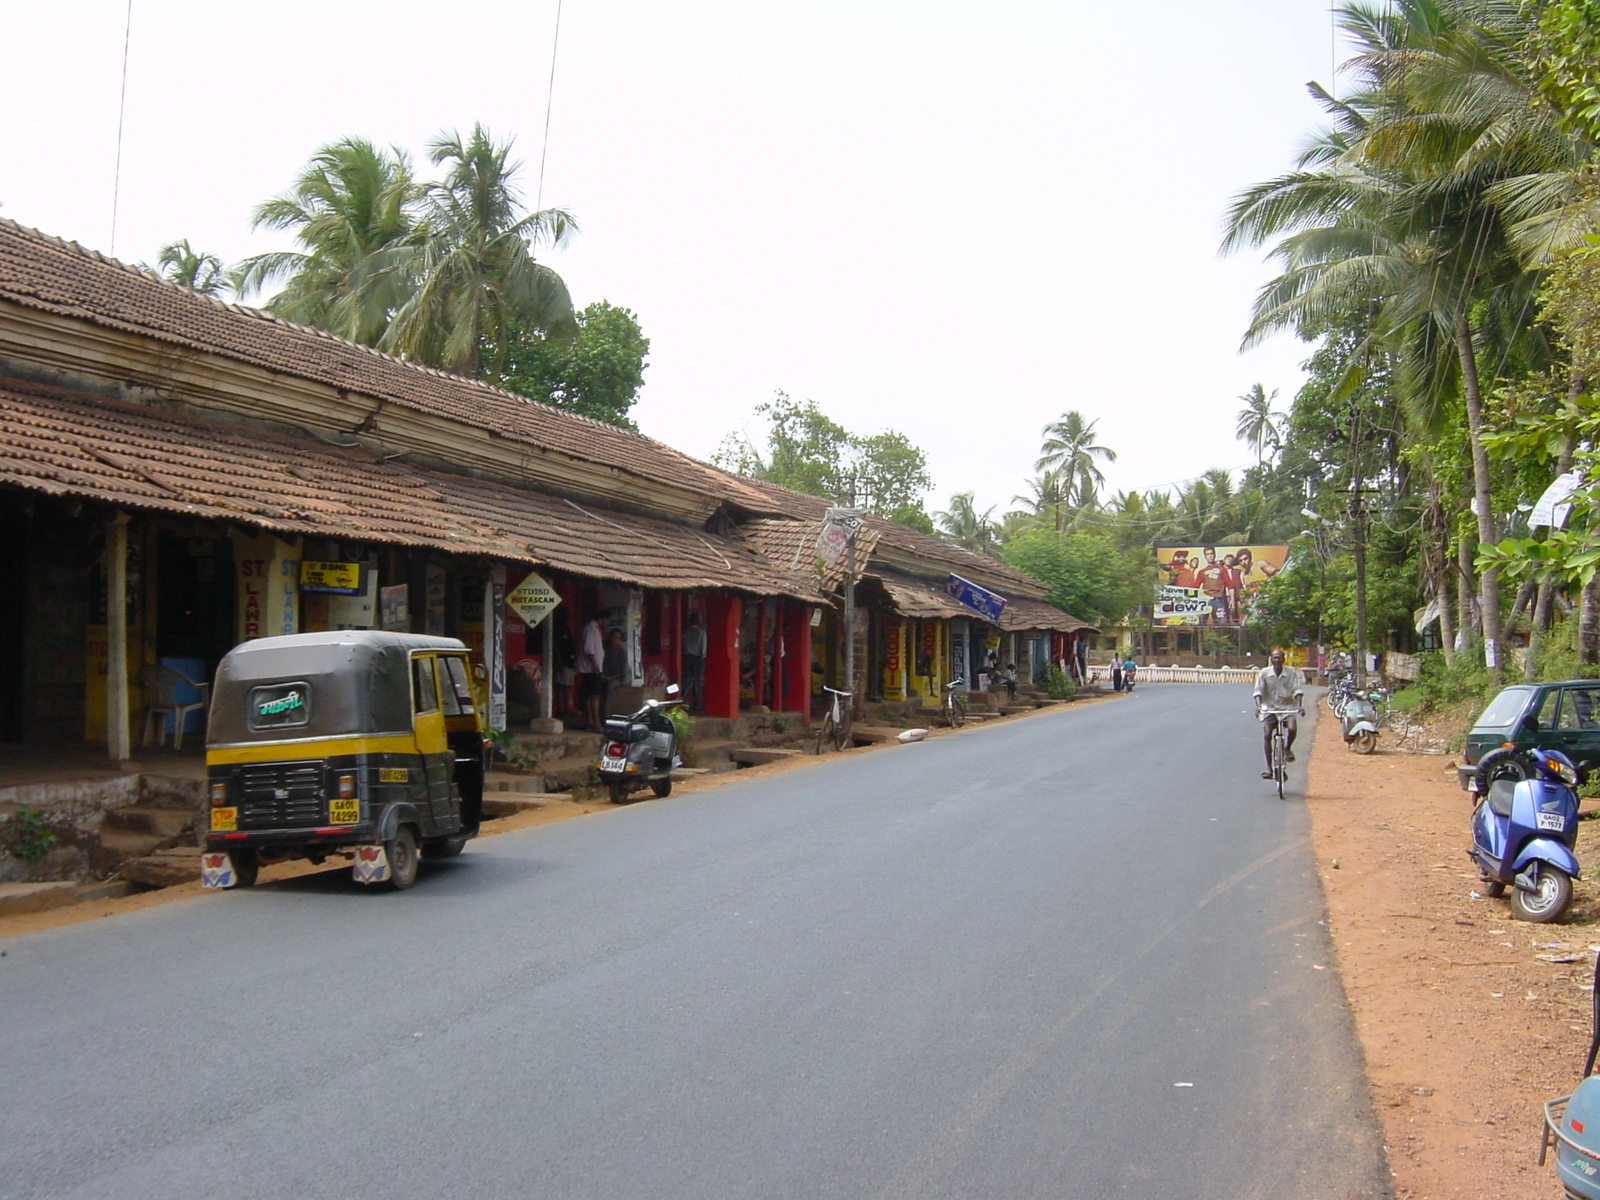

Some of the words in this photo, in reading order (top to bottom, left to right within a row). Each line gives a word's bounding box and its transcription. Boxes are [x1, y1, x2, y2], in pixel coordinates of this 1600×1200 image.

[321, 563, 348, 571] BSNL
[1162, 601, 1206, 612] dew?
[494, 613, 504, 691] PEPSI
[953, 645, 963, 682] PEPSI
[331, 811, 358, 822] T4299
